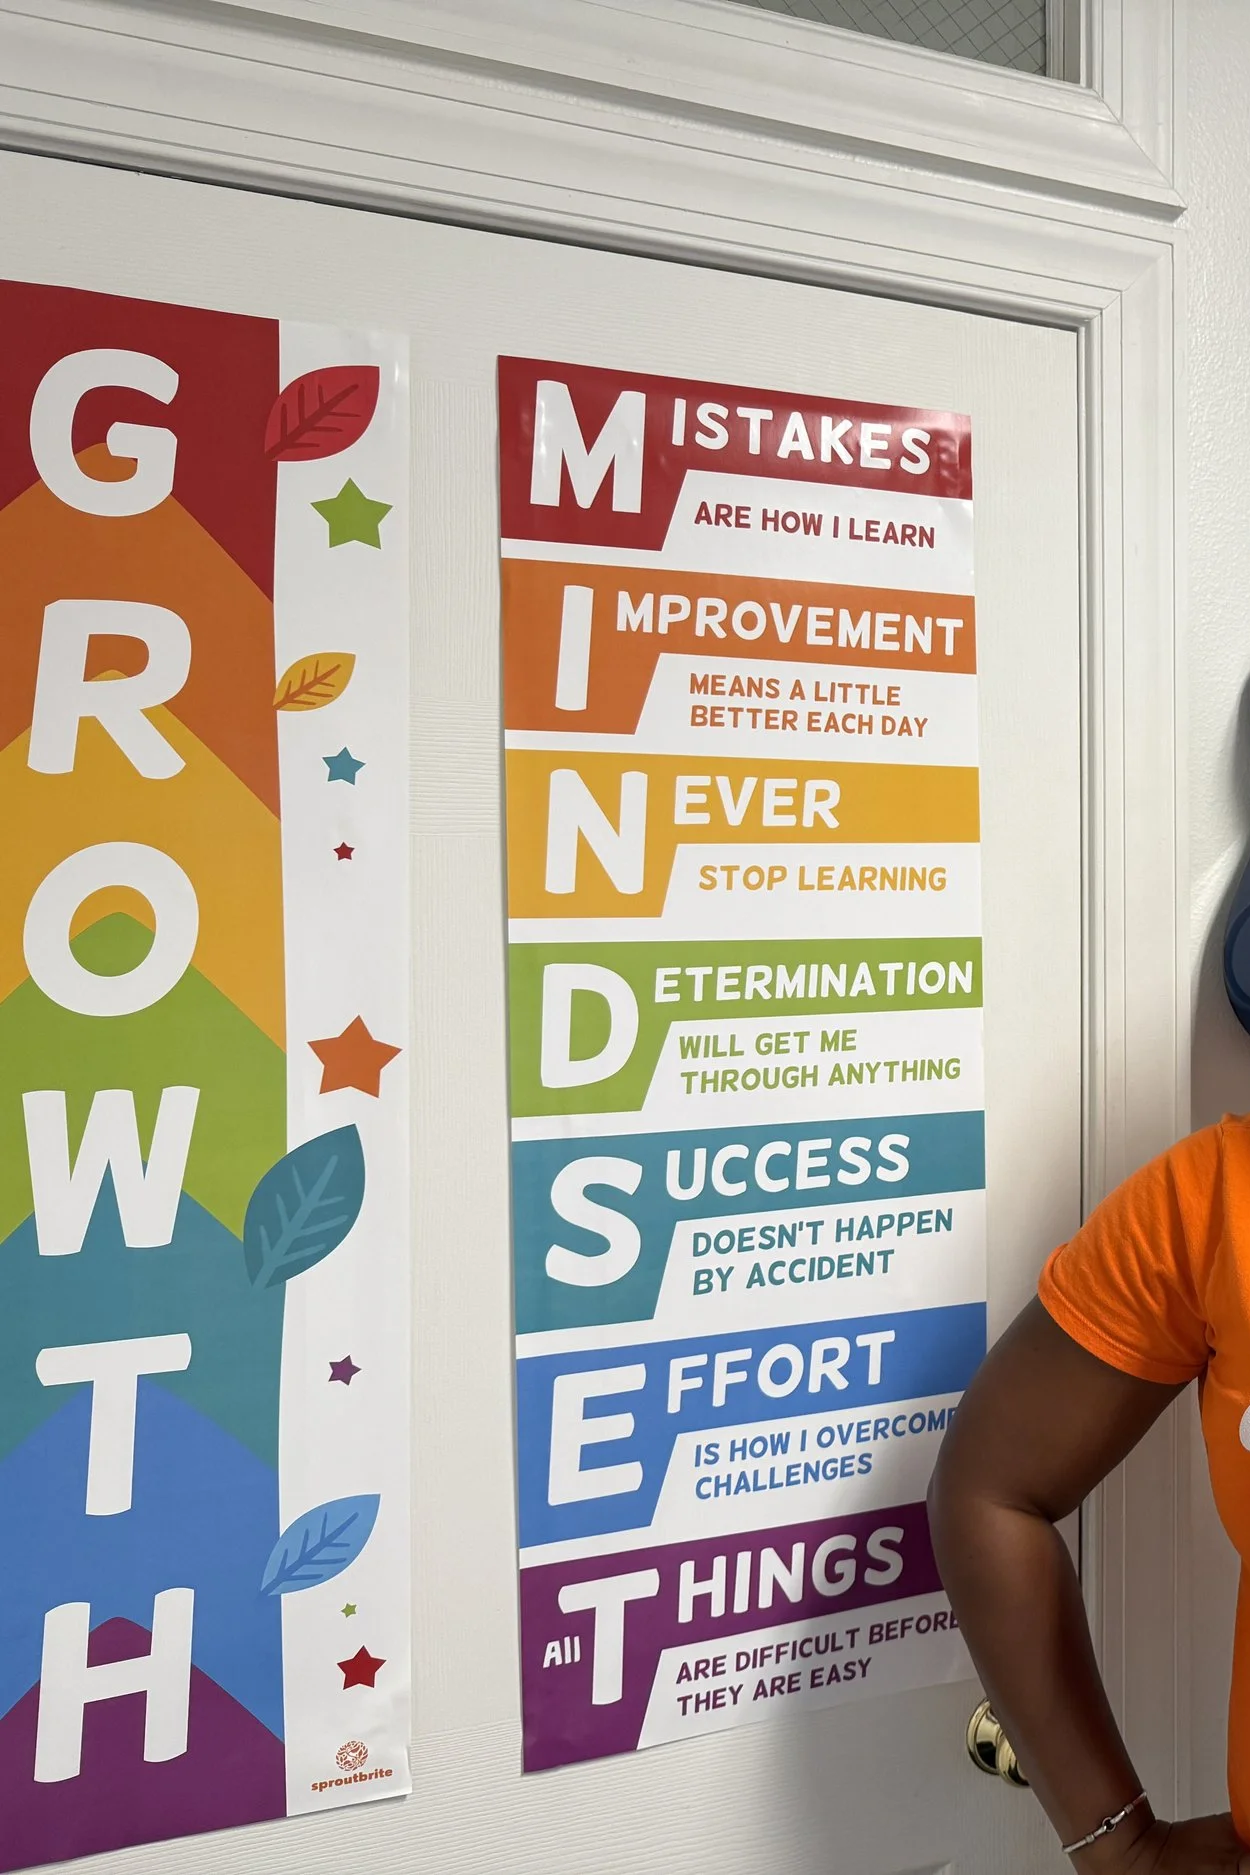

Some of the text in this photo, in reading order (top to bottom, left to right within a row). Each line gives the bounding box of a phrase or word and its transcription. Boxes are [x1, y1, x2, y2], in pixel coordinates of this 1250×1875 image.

[530, 379, 931, 513] MISTAKES
[694, 501, 936, 549] ARE HOW I LEARN
[555, 585, 963, 711] IMPROVEMENT
[689, 673, 901, 706] MEANS A LITTLE
[690, 705, 929, 737] BETTER EACH DAY
[544, 768, 841, 895] NEVER
[699, 865, 947, 891] STOP LEARNING
[540, 961, 973, 1089] DETERMINATION
[679, 1028, 858, 1060] WILL GET ME
[22, 348, 200, 1783] GROWTH
[680, 1057, 961, 1095] THROUGH ANYTHING
[545, 1133, 910, 1287] SUCCESS
[692, 1208, 953, 1257] DOESN'T HAPPEN
[692, 1249, 895, 1296] BY ACCIDENT
[547, 1329, 896, 1506] EFFORT
[694, 1443, 720, 1467] IS
[729, 1432, 790, 1463] HOW
[800, 1429, 808, 1452] I
[695, 1452, 873, 1500] CHALLENGES
[557, 1526, 905, 1706] THINGS
[676, 1655, 727, 1684] ARE
[735, 1627, 861, 1672] DIFFICULT
[677, 1656, 872, 1716] THEY ARE EASY
[311, 1768, 393, 1792] sproutbrite
